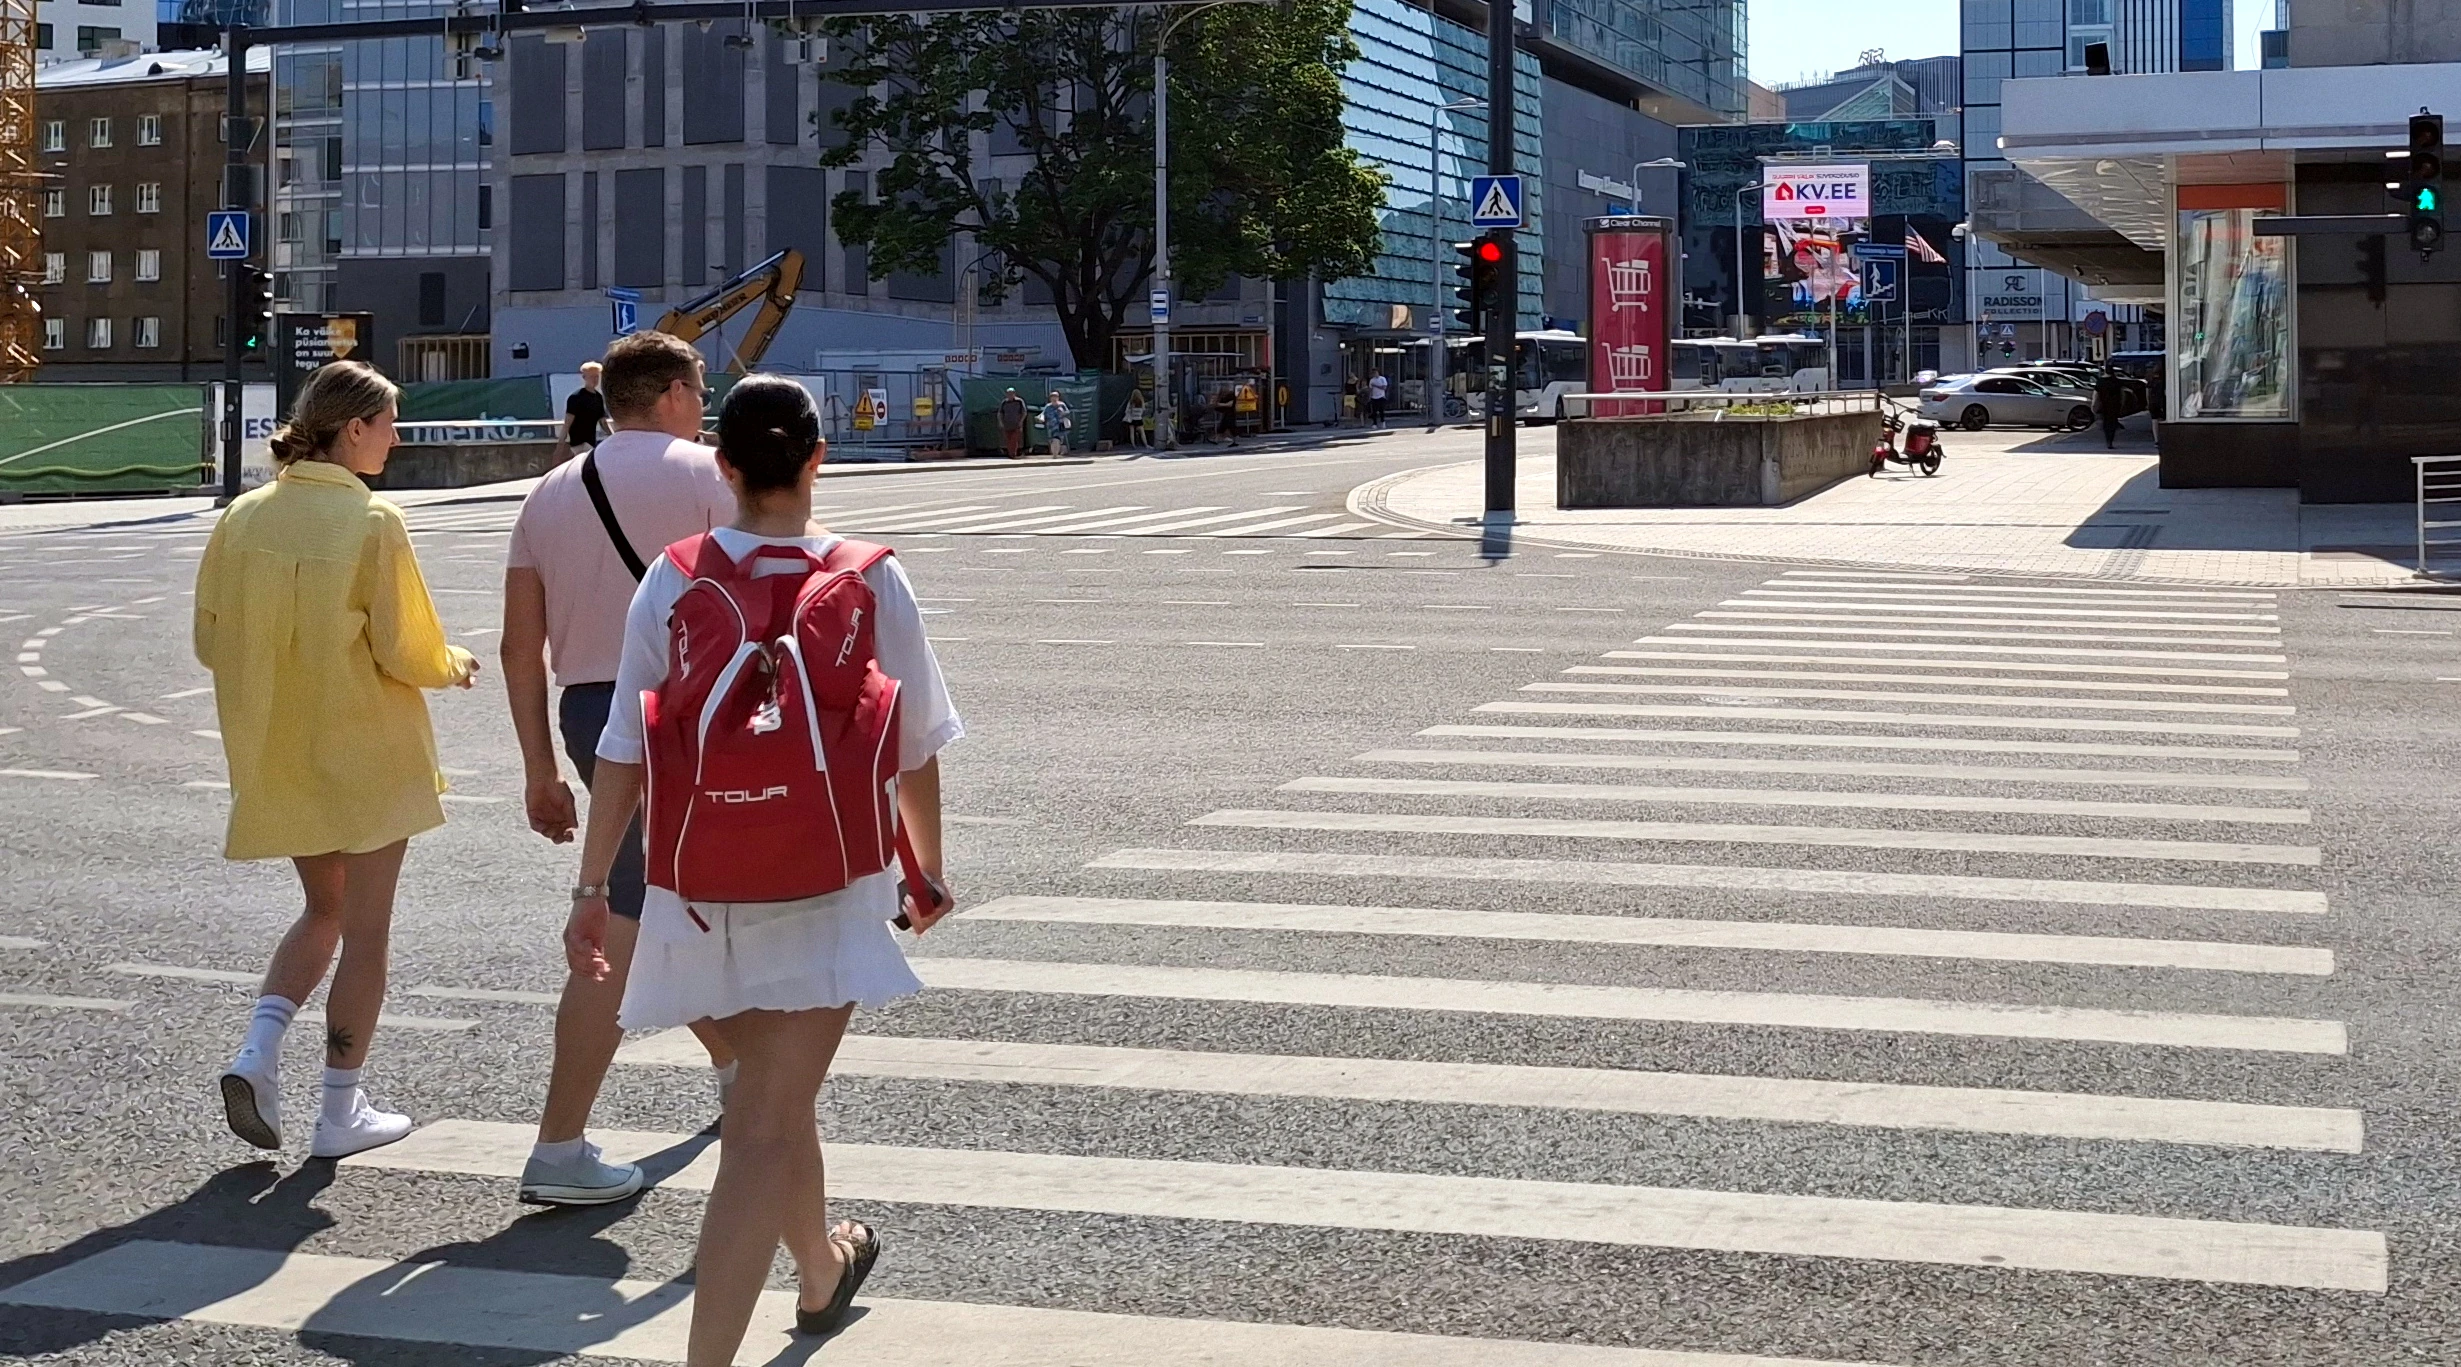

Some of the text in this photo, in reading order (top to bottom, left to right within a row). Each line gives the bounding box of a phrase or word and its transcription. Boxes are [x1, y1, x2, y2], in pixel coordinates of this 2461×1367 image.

[1796, 183, 1857, 200] KV.EE
[1611, 219, 1660, 227] Clear Channel
[295, 326, 310, 336] Ka
[295, 360, 320, 371] tegu
[835, 607, 864, 667] TOUR
[677, 619, 691, 682] TOUR
[704, 785, 788, 804] TOUR
